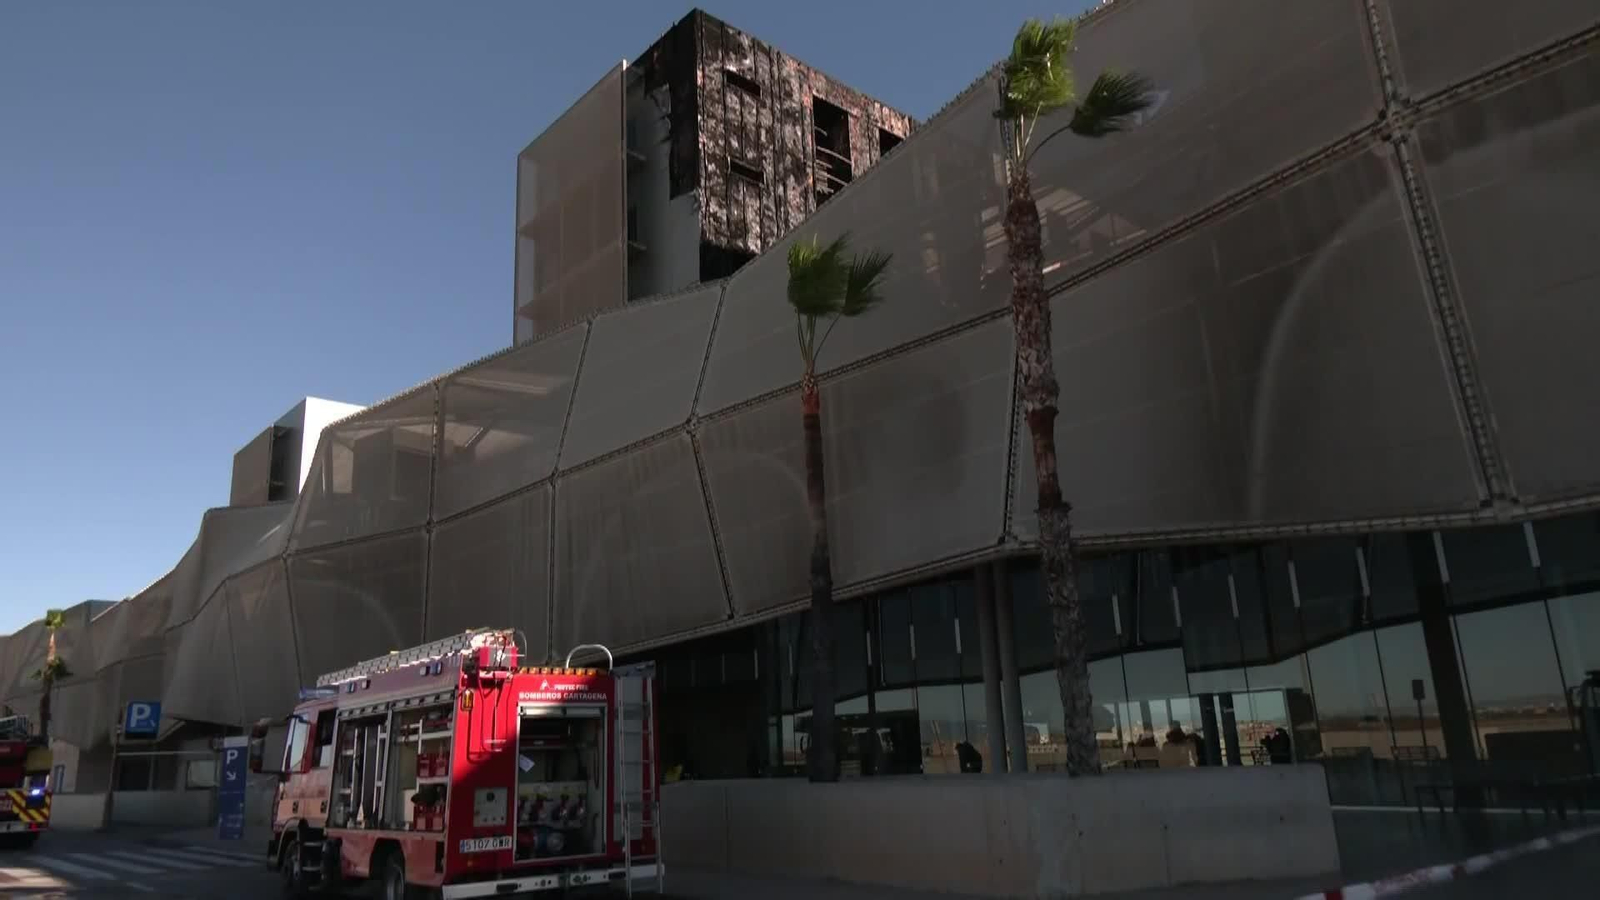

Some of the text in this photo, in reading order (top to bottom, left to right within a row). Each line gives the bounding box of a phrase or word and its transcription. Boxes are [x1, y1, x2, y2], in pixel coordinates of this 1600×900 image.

[518, 692, 562, 700] BOMBEROS
[131, 703, 151, 728] P
[226, 749, 239, 765] P
